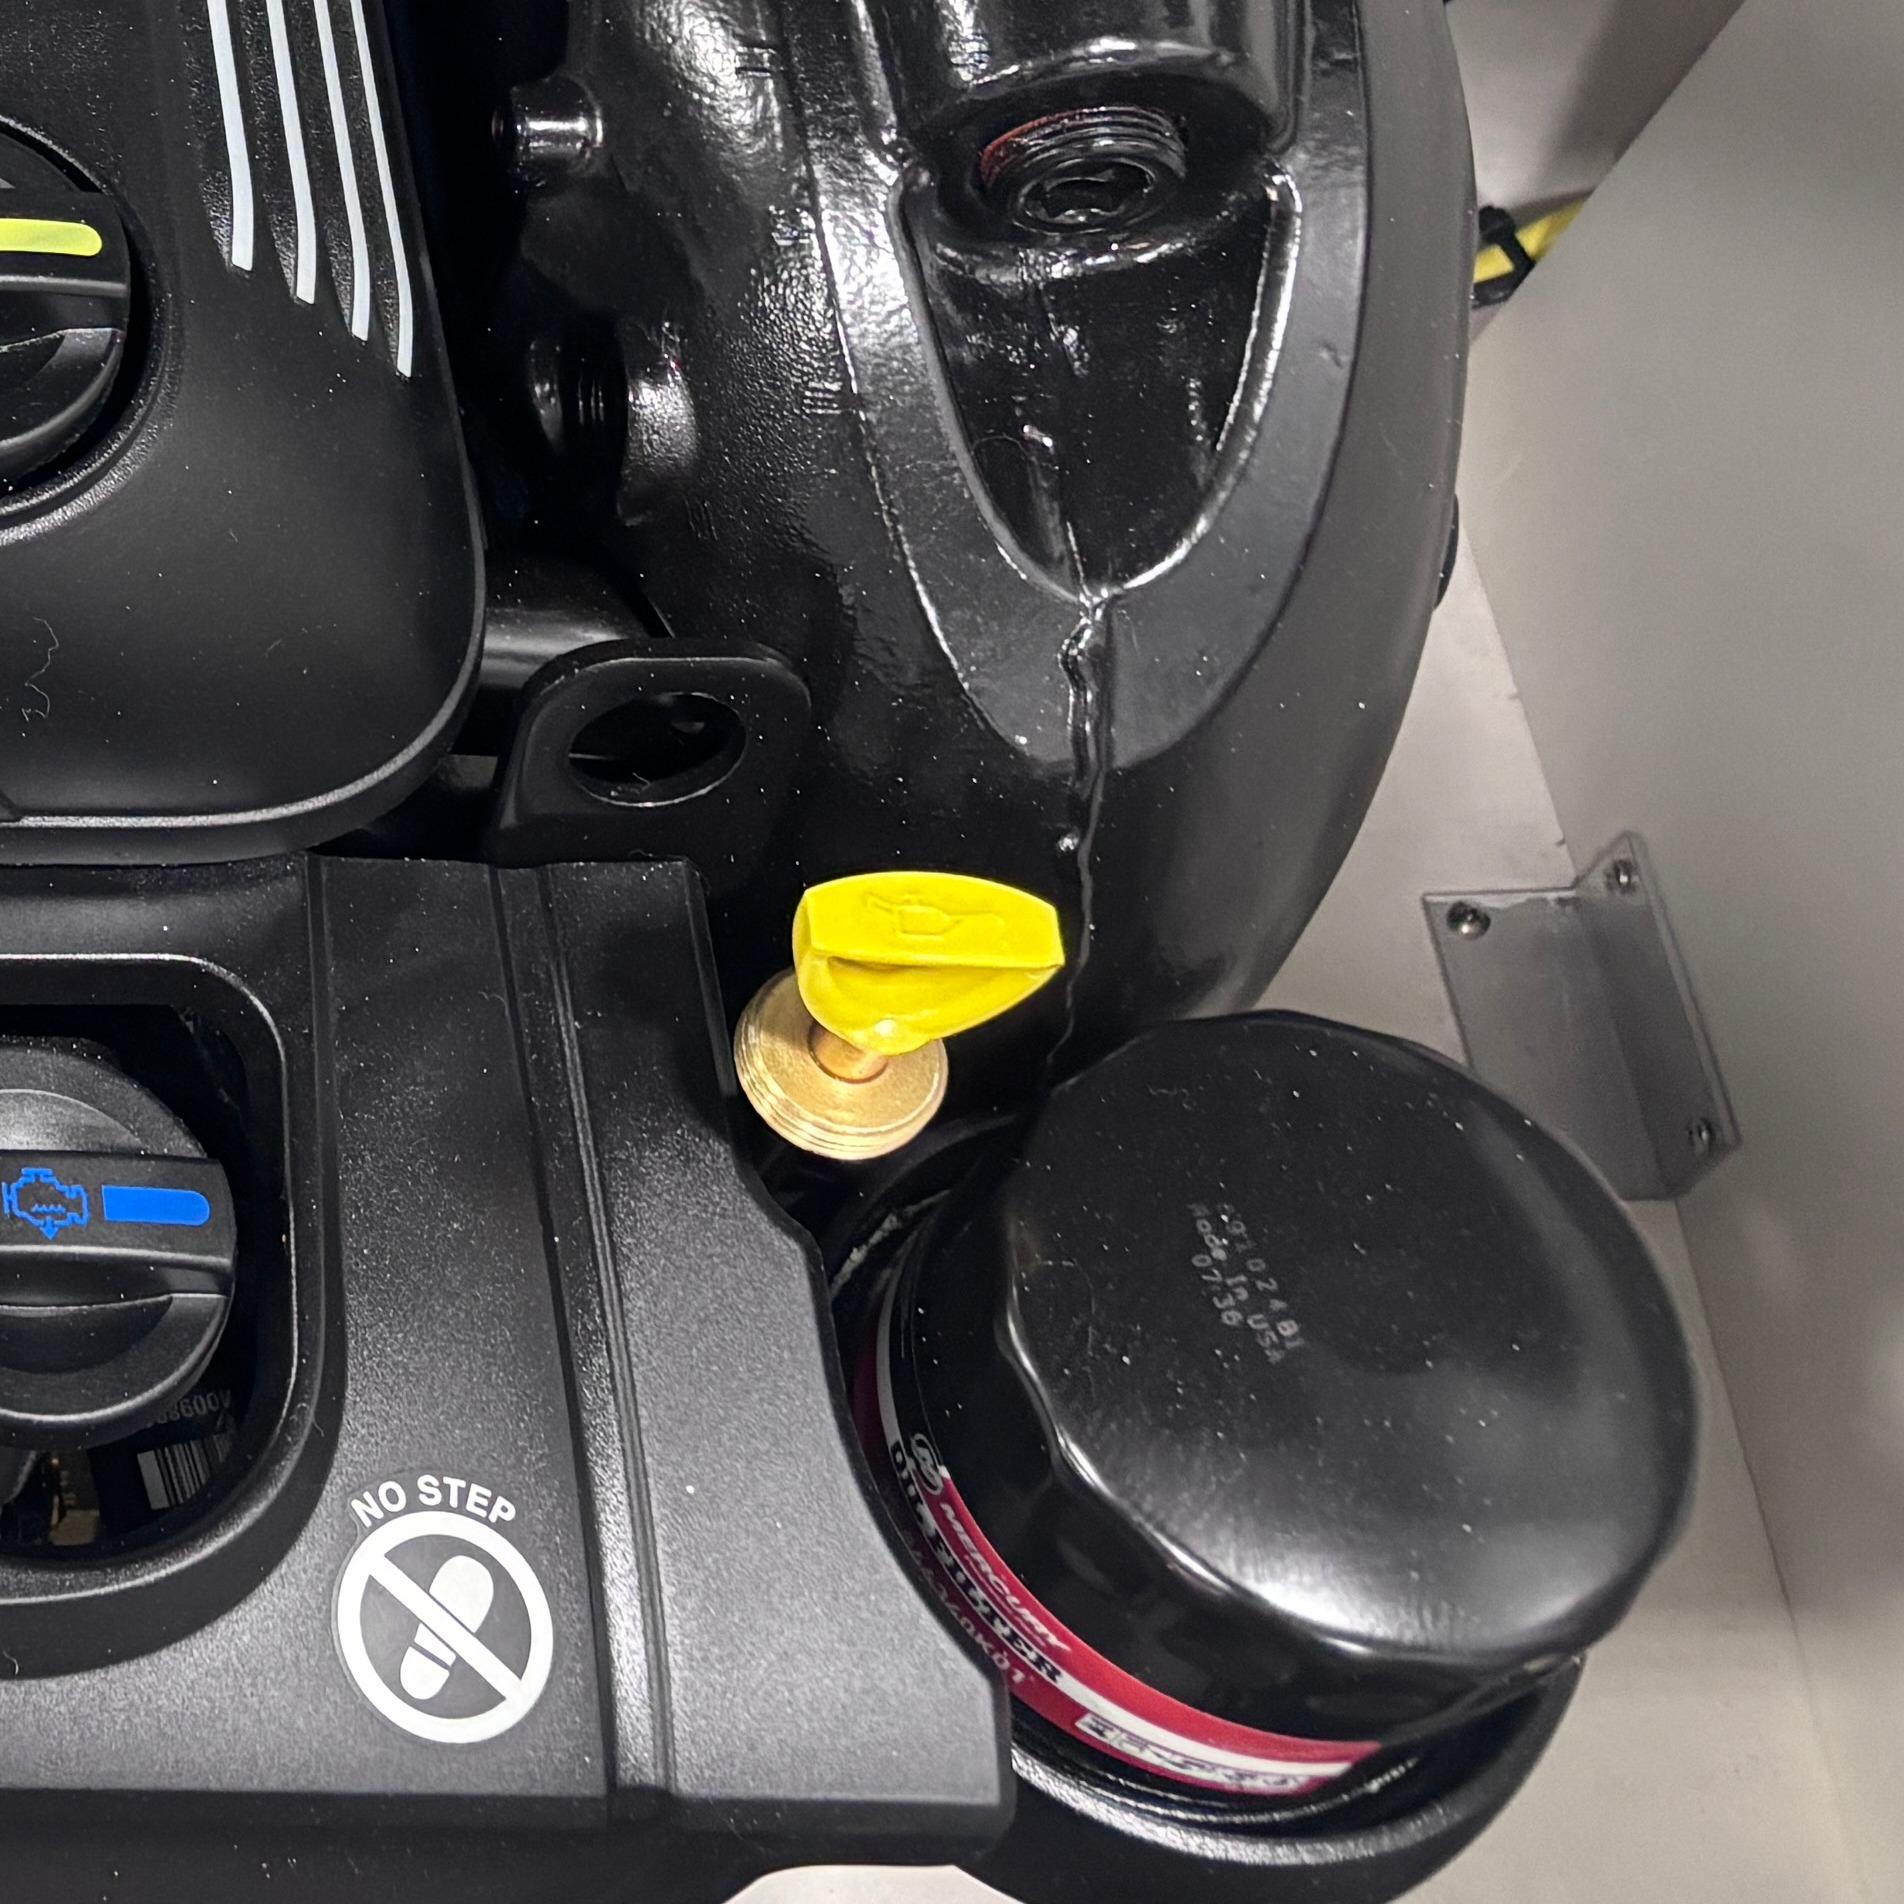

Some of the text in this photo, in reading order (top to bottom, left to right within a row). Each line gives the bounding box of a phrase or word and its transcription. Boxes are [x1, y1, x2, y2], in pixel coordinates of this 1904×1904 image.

[350, 1474, 517, 1528] NO STEP
[939, 1501, 1072, 1653] MERCURY
